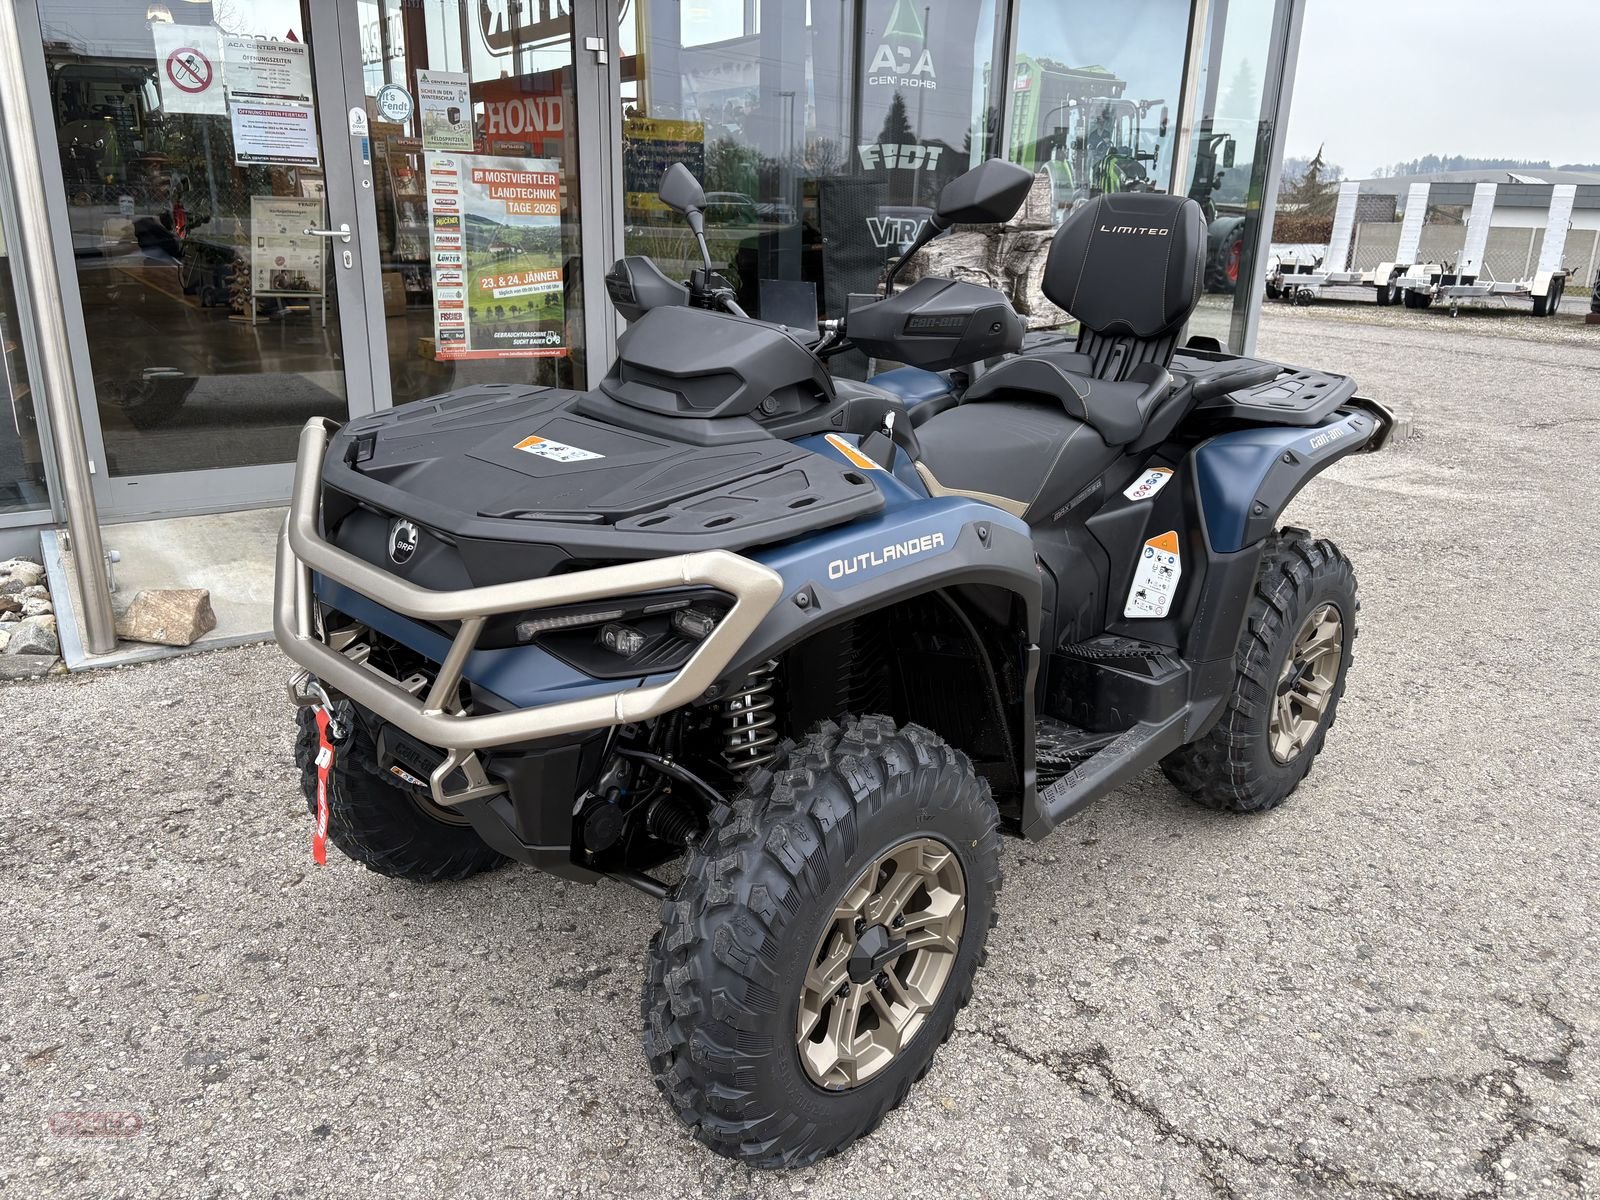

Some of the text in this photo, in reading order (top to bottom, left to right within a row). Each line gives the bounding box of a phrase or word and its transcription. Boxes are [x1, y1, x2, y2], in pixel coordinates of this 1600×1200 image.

[247, 43, 276, 51] CENTER
[242, 54, 292, 64] ÖFFNUNGSZEITEN
[900, 78, 937, 90] ROHER
[485, 172, 556, 185] MOSTVIERTLER
[491, 187, 556, 199] LANDTECHNIK
[508, 202, 557, 214] TAGE 2026
[1100, 224, 1169, 236] LIMITED
[482, 270, 559, 288] 23. & 24. JÄNNER
[396, 540, 414, 552] BRP
[828, 532, 944, 580] OUTLANDER
